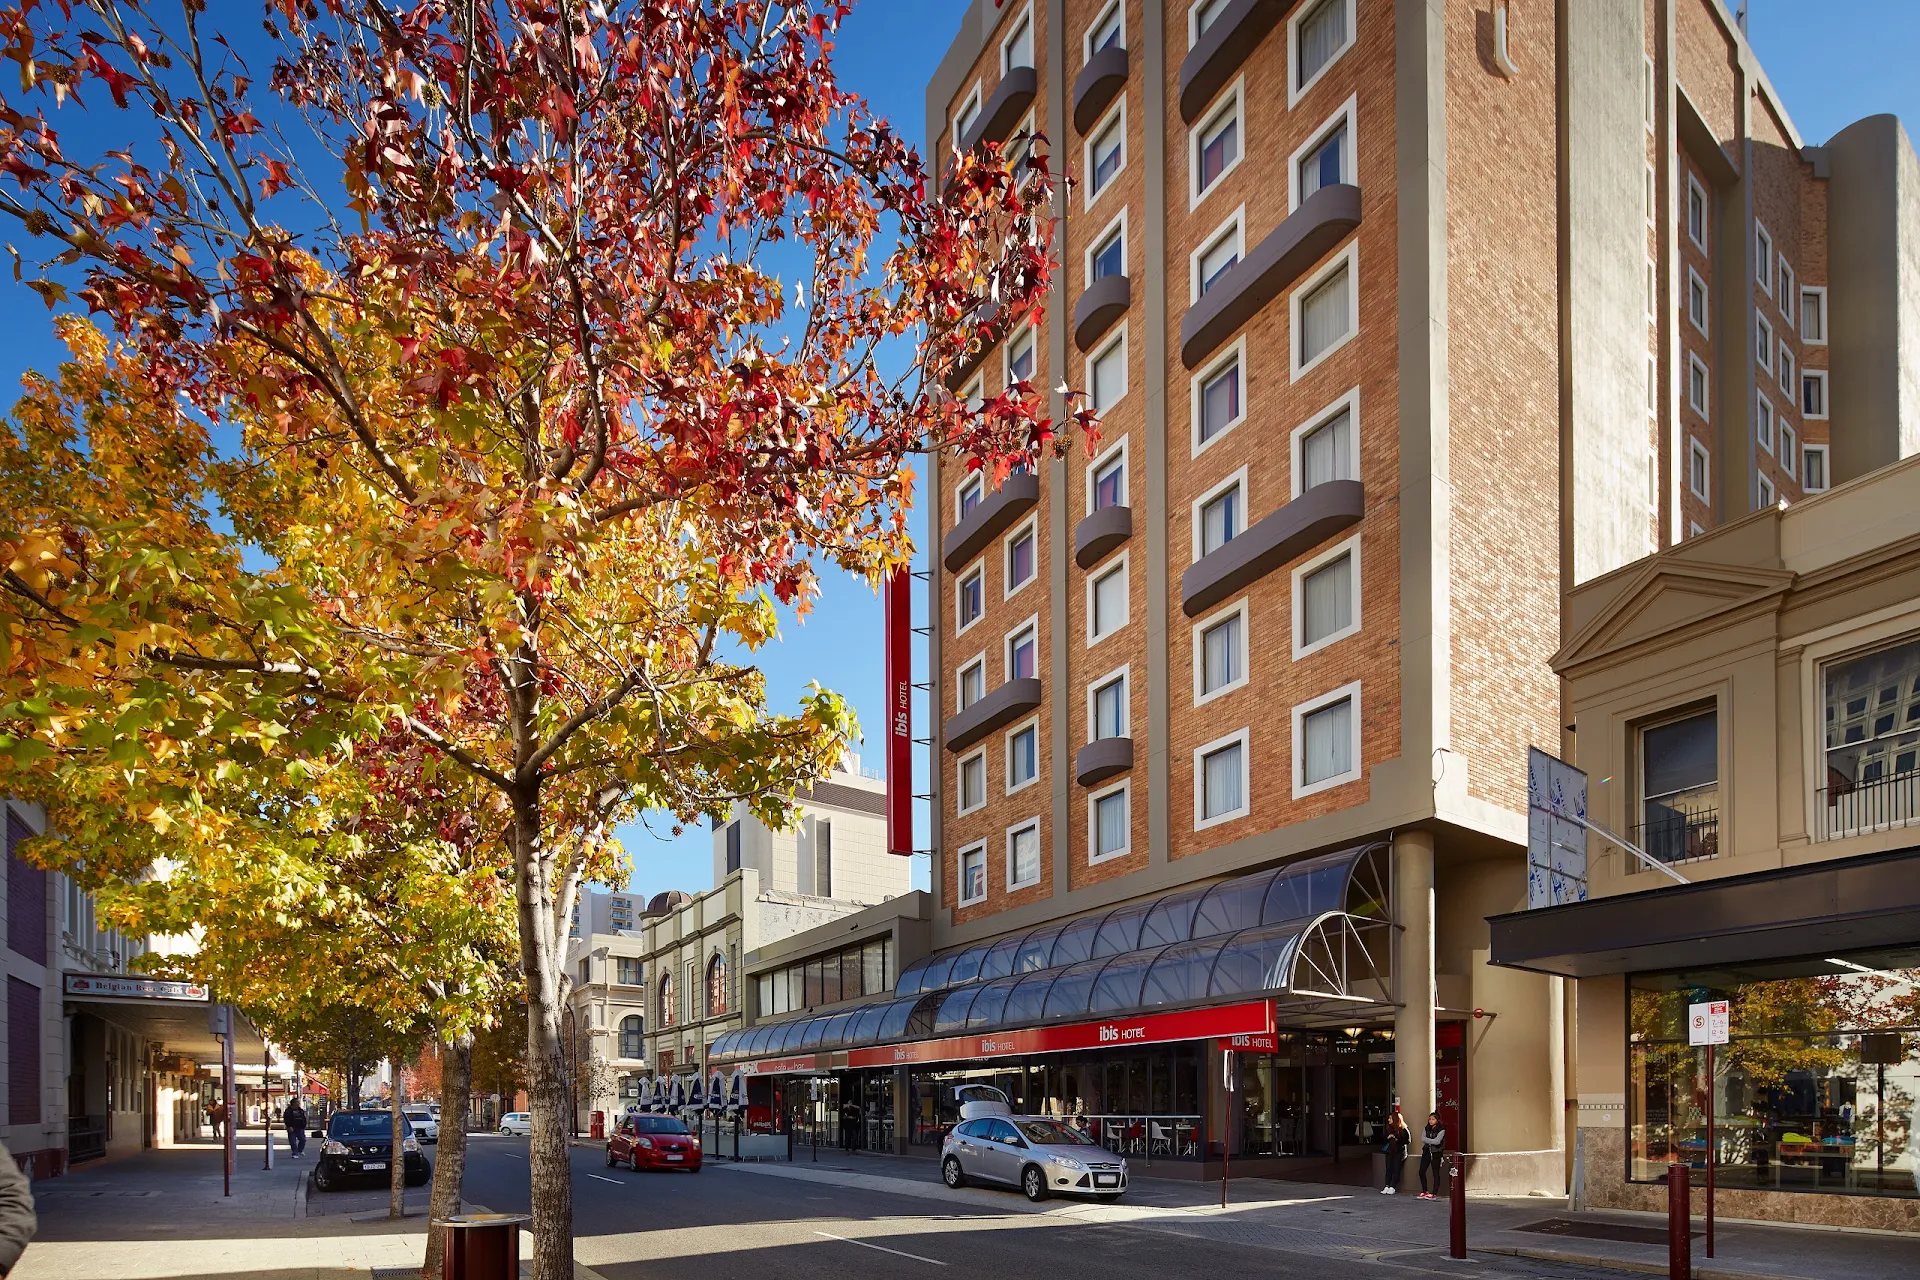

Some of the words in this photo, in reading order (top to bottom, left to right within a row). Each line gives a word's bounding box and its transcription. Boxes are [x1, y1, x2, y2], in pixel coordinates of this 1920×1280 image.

[899, 680, 908, 709] HOTEL
[895, 712, 908, 738] ibis
[95, 981, 132, 992] Belgian
[136, 985, 157, 993] Beer
[1100, 1026, 1118, 1041] ibis
[1121, 1026, 1145, 1040] HOTEL
[982, 1039, 996, 1052] ibis
[997, 1041, 1016, 1051] HOTEL
[1252, 1038, 1273, 1048] HOTEL
[894, 1049, 905, 1060] ibis
[906, 1051, 919, 1060] HOTEL
